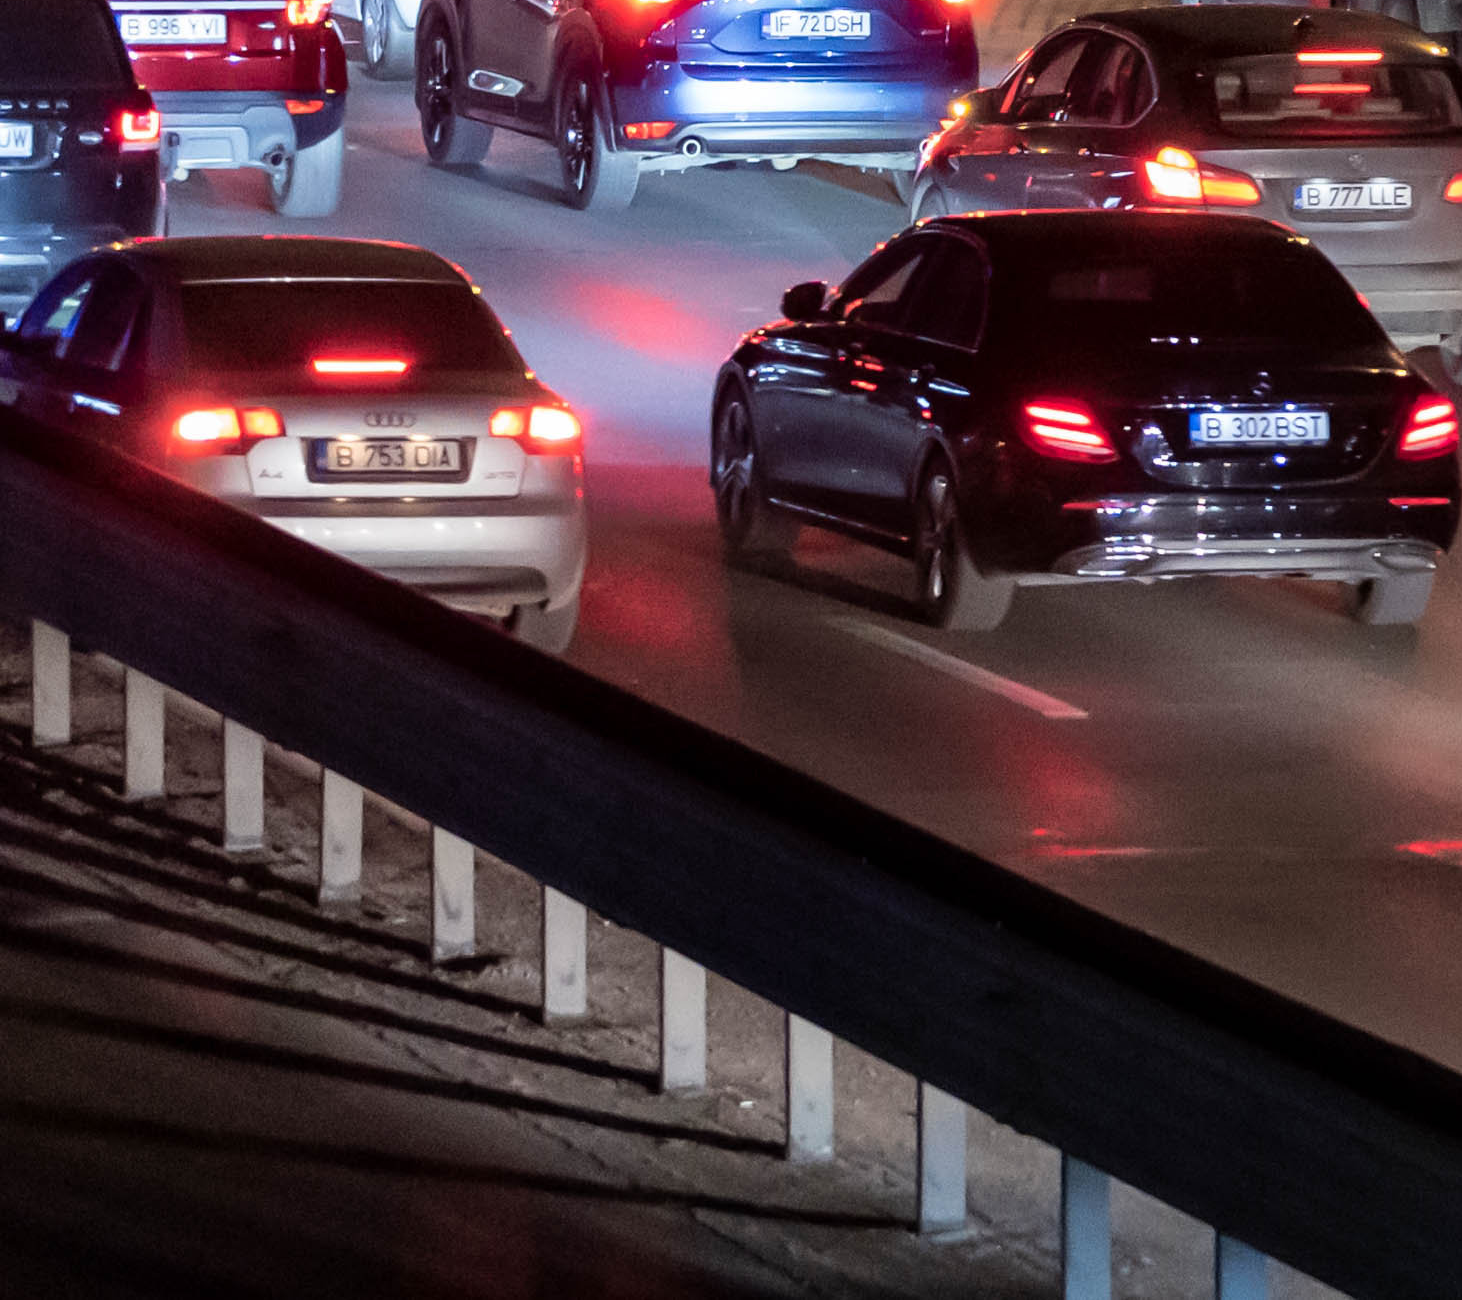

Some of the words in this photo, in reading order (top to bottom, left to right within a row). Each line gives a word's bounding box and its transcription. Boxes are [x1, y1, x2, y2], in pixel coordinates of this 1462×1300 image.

[127, 18, 140, 36] B
[148, 18, 180, 35] 996
[189, 18, 219, 35] YVI
[776, 15, 790, 32] IF
[1307, 187, 1321, 206] B
[1329, 186, 1364, 206] 777
[1370, 186, 1409, 206] LLE
[1206, 417, 1221, 439] B
[336, 445, 353, 468] B
[364, 444, 407, 468] 753
